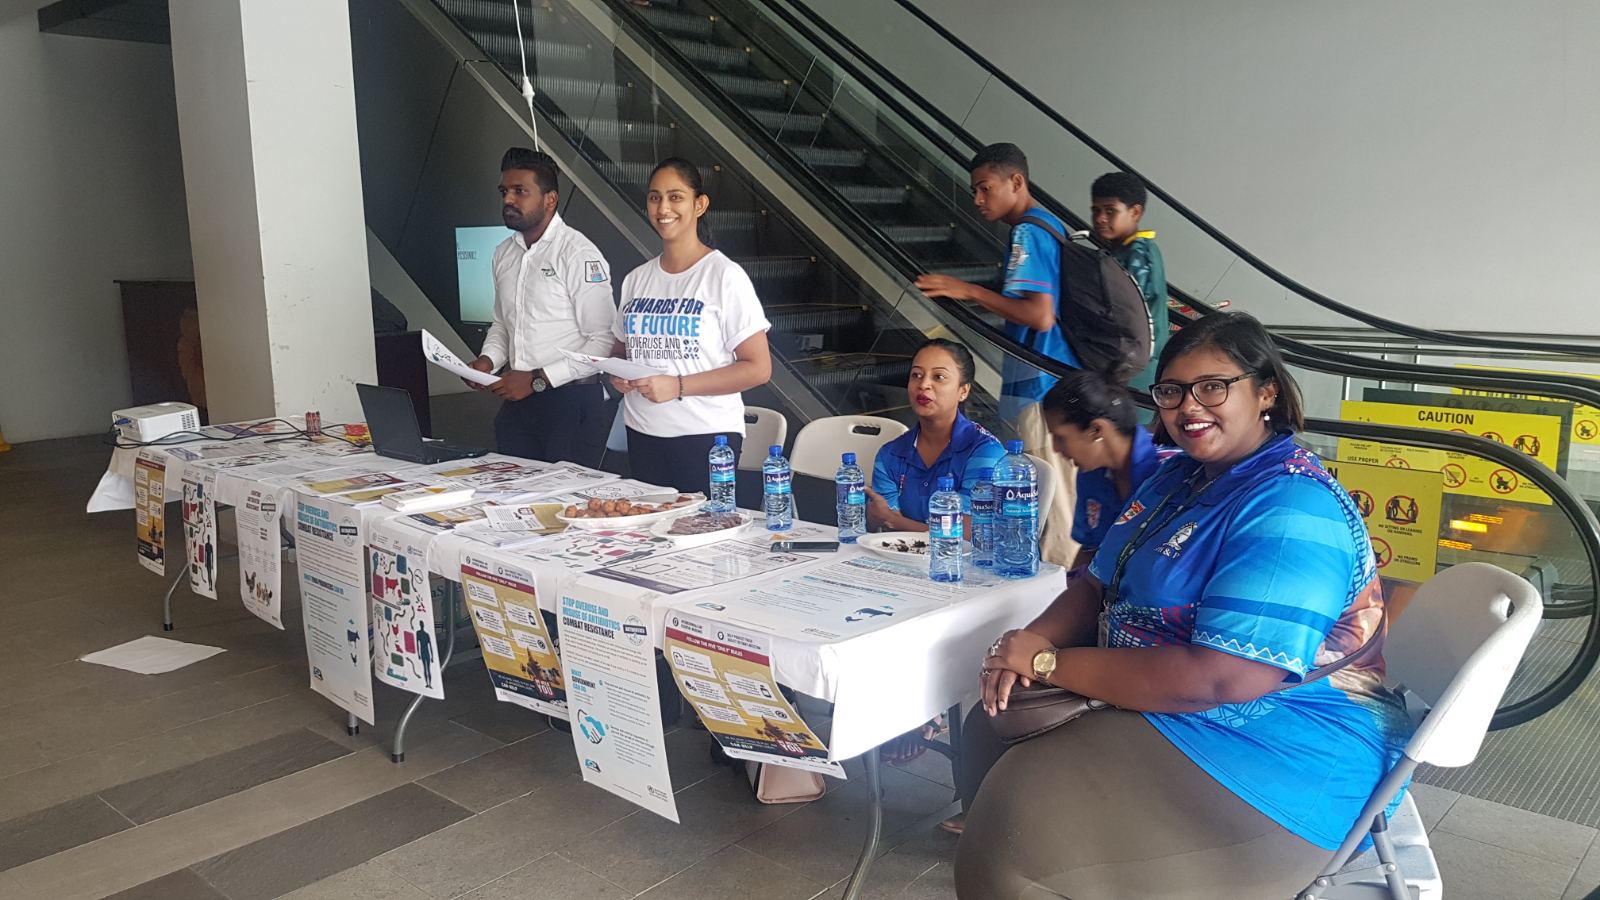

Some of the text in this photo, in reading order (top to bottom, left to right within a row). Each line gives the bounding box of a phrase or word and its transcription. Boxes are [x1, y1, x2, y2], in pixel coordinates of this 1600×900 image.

[678, 298, 704, 314] FOR
[642, 315, 700, 337] FUTURE
[630, 336, 662, 349] OVERUSE
[665, 338, 681, 350] AND
[634, 348, 642, 359] OF
[643, 350, 682, 360] ANTIBIOTICS
[1418, 410, 1474, 425] CAUTION
[562, 596, 608, 617] STOP OVERUSE AND
[562, 607, 620, 631] MISUSE OF ANTIBIOTICS
[562, 616, 614, 639] COMBAT RESISTANCE
[536, 682, 553, 695] YOU
[572, 676, 596, 688] GOVERNMENT
